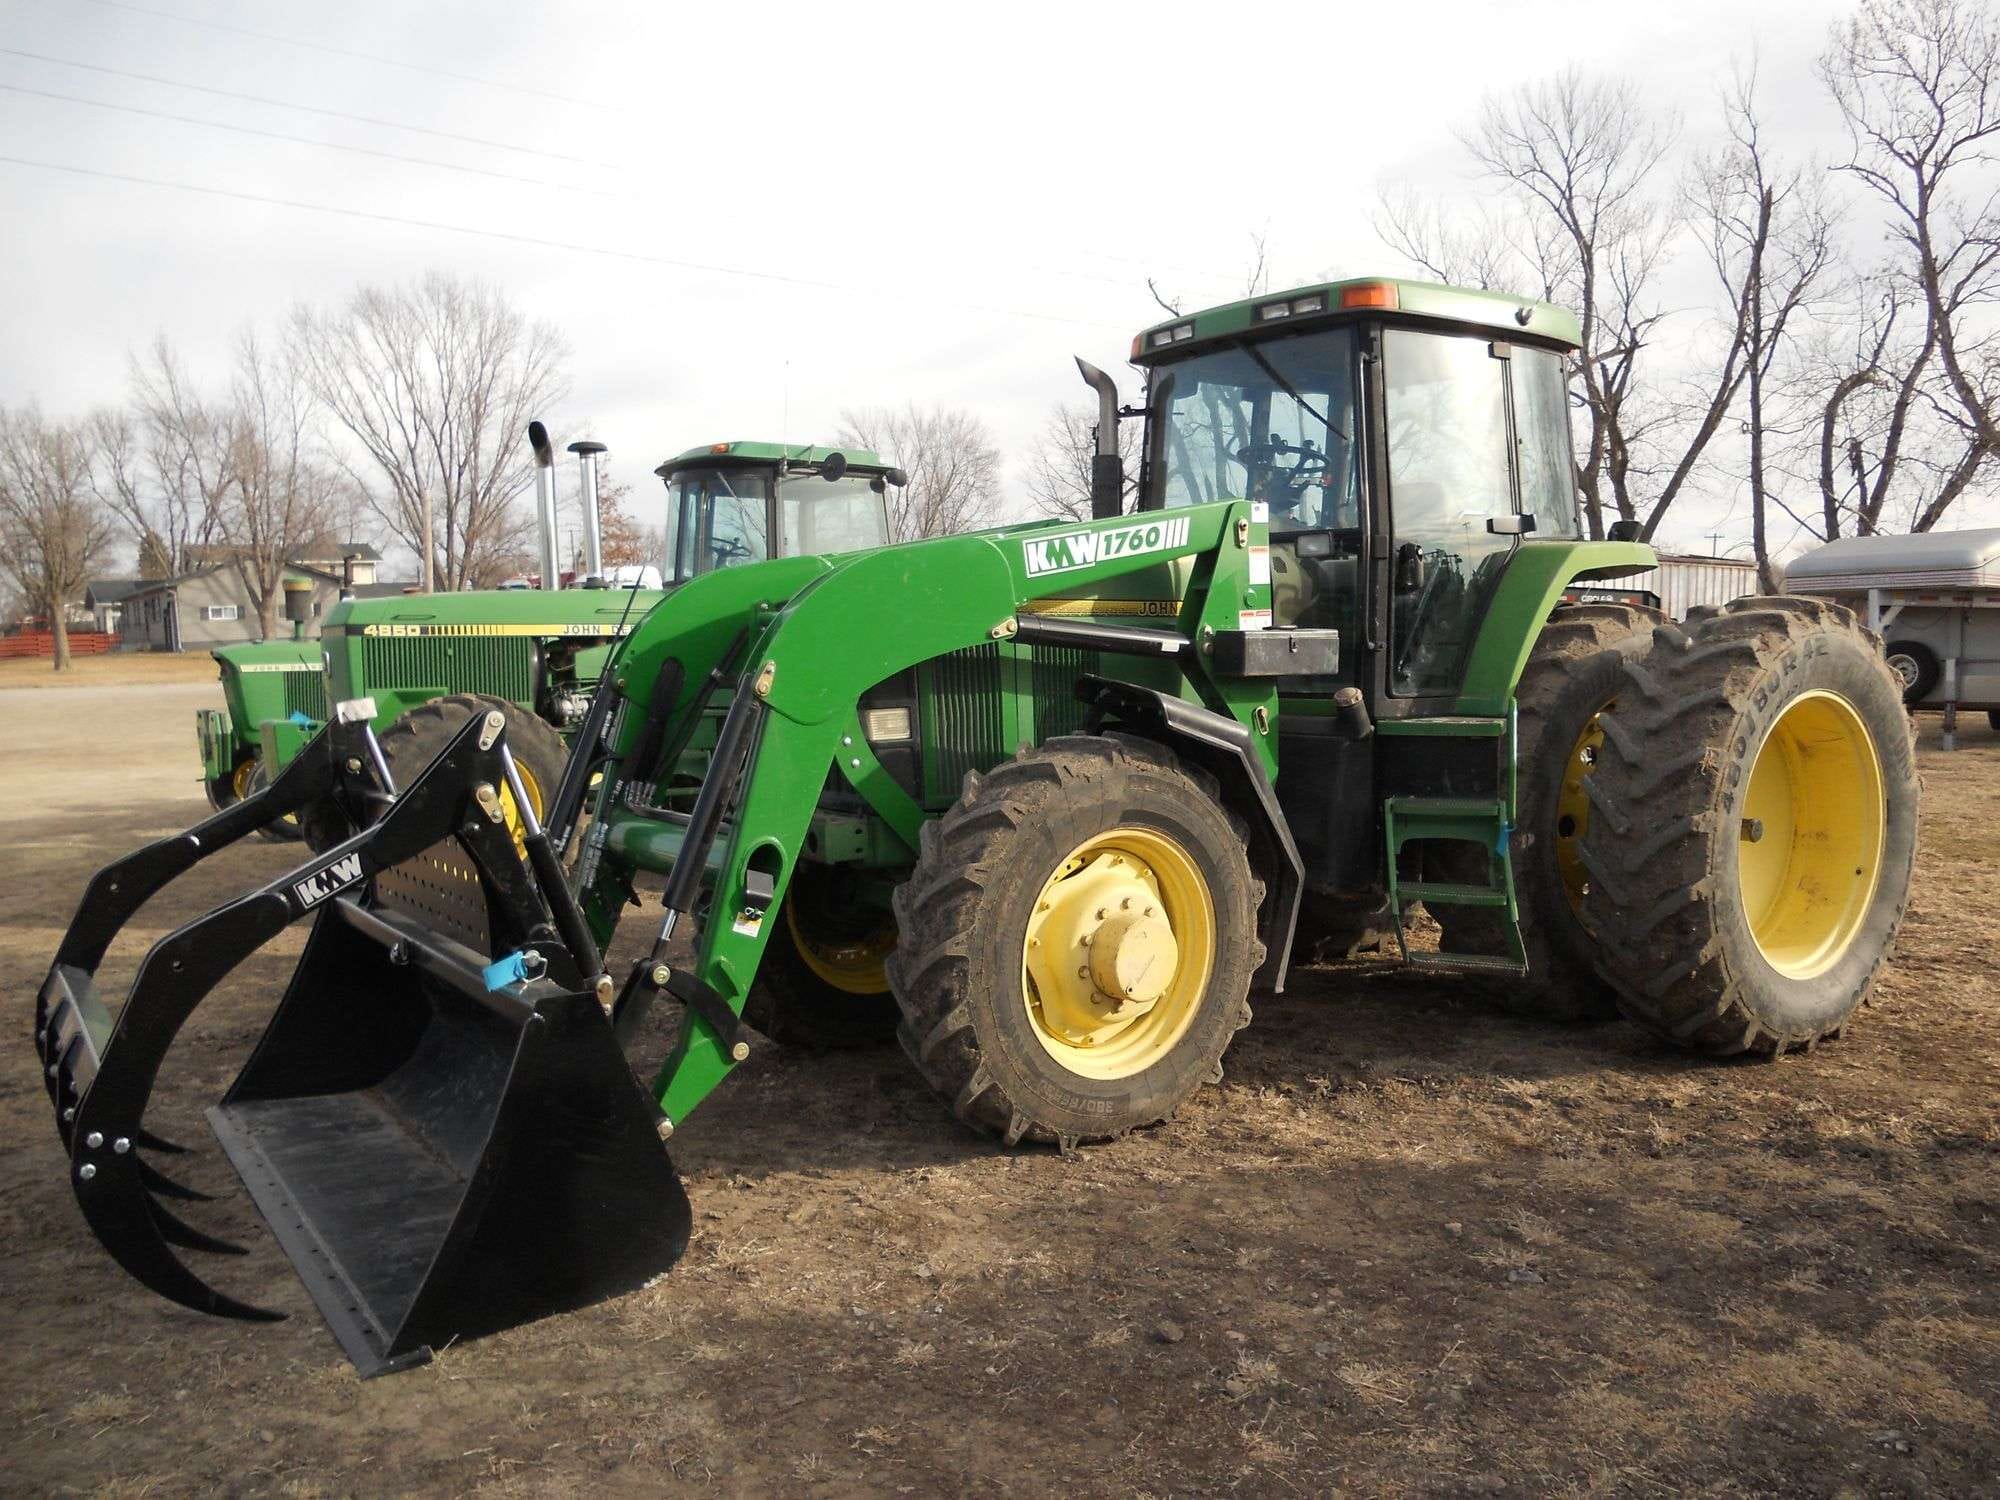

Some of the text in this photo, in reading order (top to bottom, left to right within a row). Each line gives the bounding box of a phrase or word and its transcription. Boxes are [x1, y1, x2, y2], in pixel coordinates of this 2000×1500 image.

[1025, 526, 1161, 574] KMW 1760
[1137, 601, 1178, 616] JOHN
[563, 625, 600, 634] JOHN
[297, 852, 362, 904] KMW
